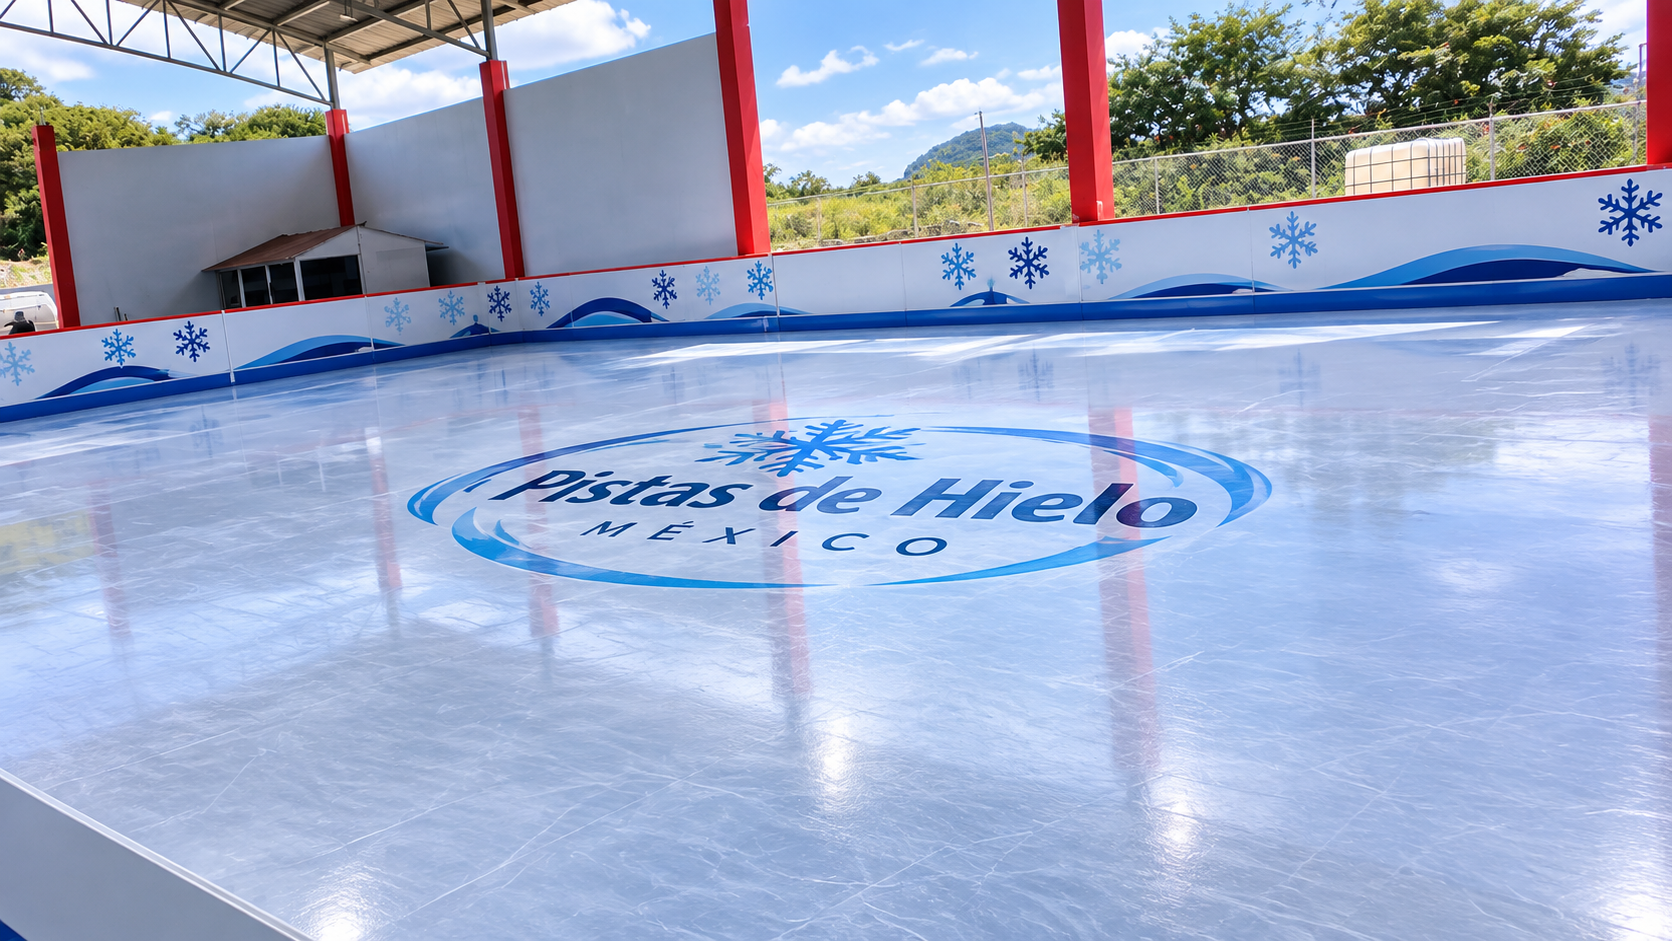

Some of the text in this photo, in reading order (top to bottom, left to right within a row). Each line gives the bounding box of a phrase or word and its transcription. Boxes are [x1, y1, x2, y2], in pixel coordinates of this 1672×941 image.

[487, 469, 1198, 528] Pistas de Hielo
[579, 520, 948, 556] MÉXICO
